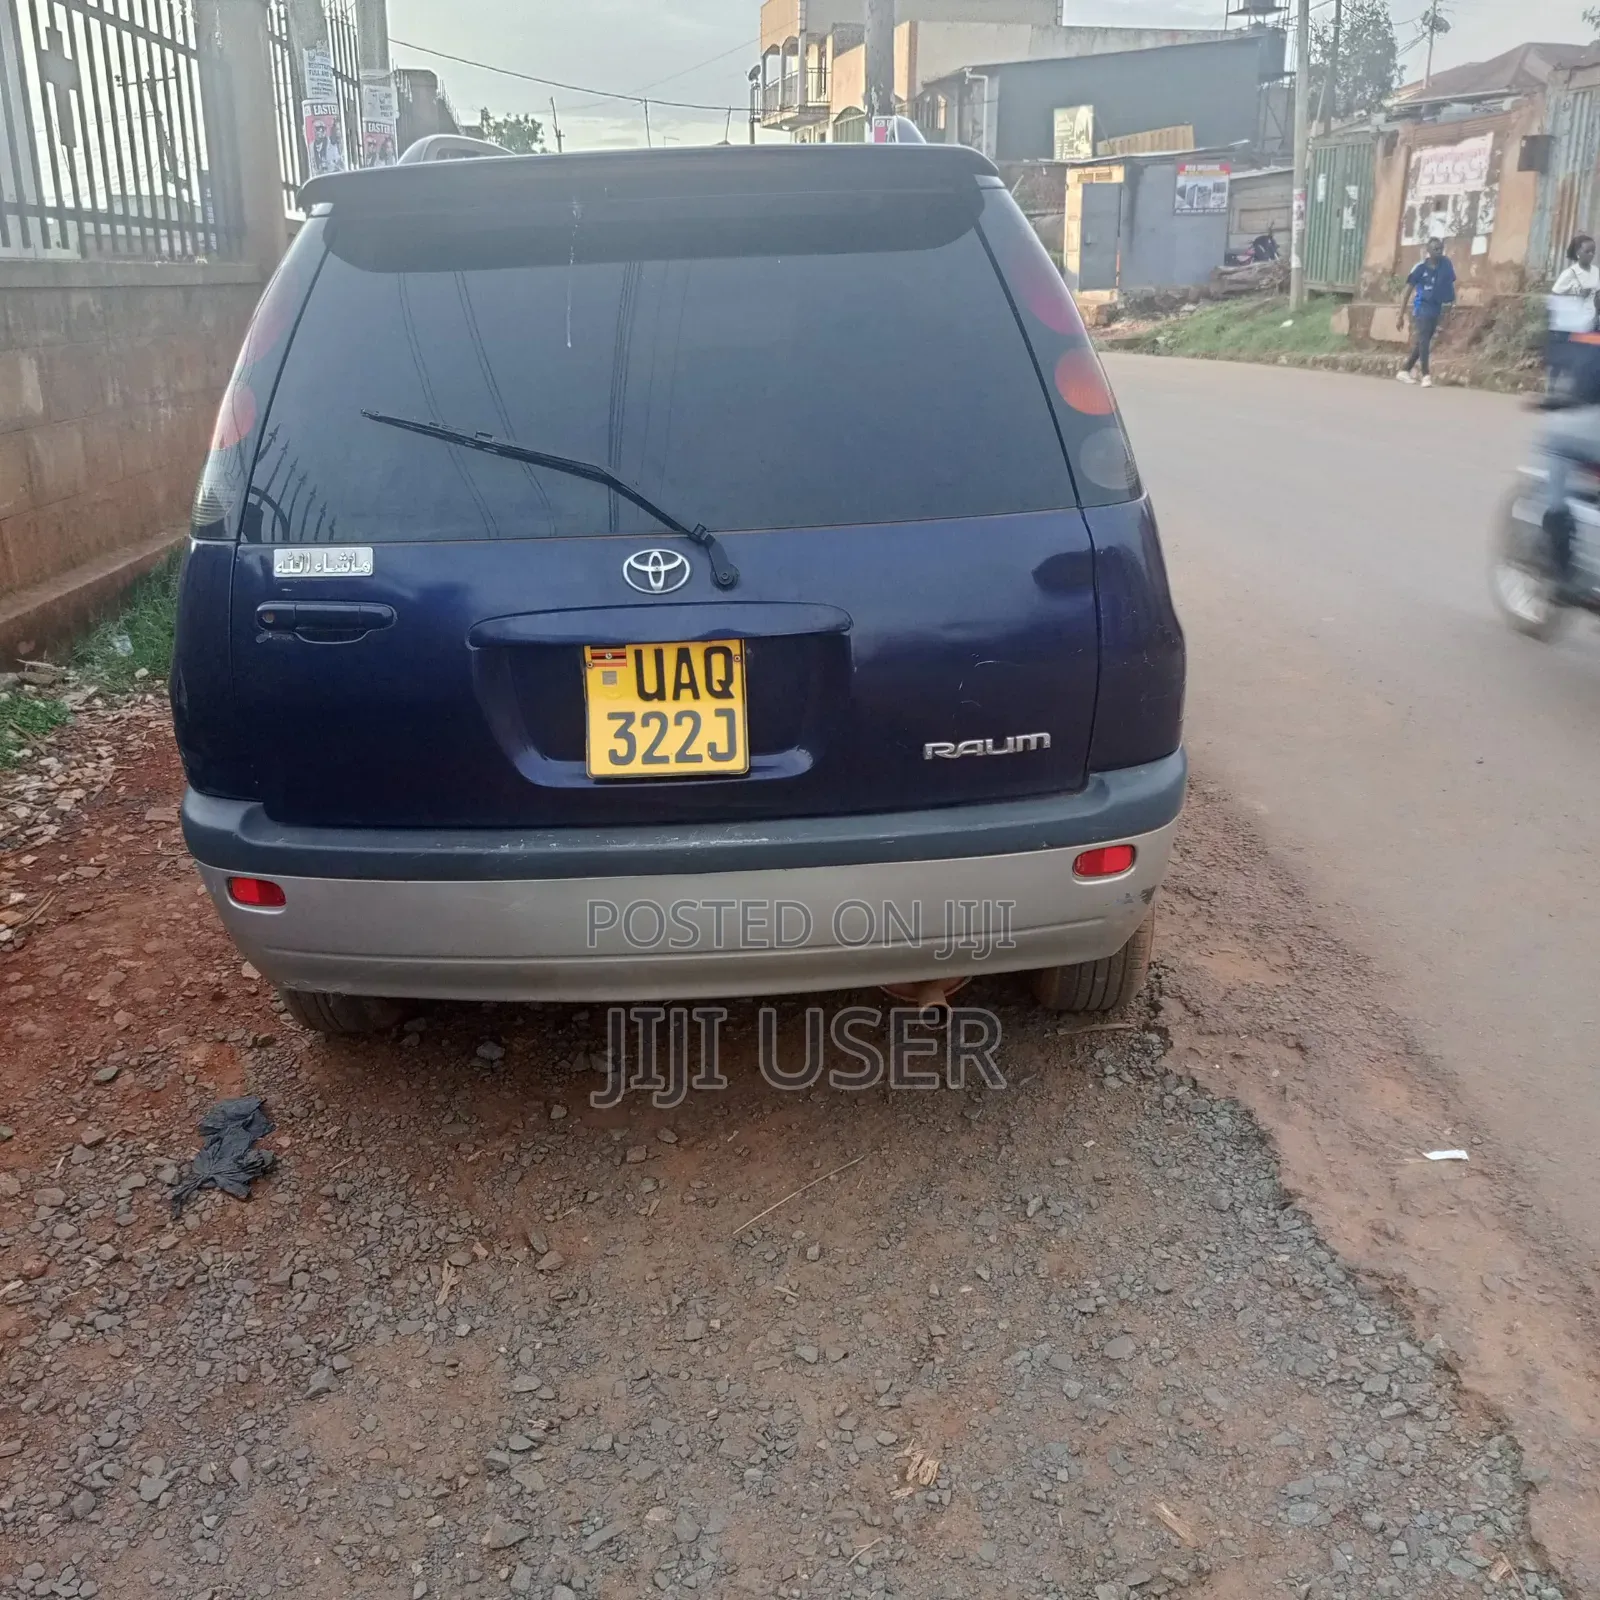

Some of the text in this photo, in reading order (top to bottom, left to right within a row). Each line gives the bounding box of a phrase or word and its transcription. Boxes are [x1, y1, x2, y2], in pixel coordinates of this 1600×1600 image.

[274, 551, 312, 574] الله
[634, 646, 735, 701] UAQ
[607, 707, 737, 766] 322J
